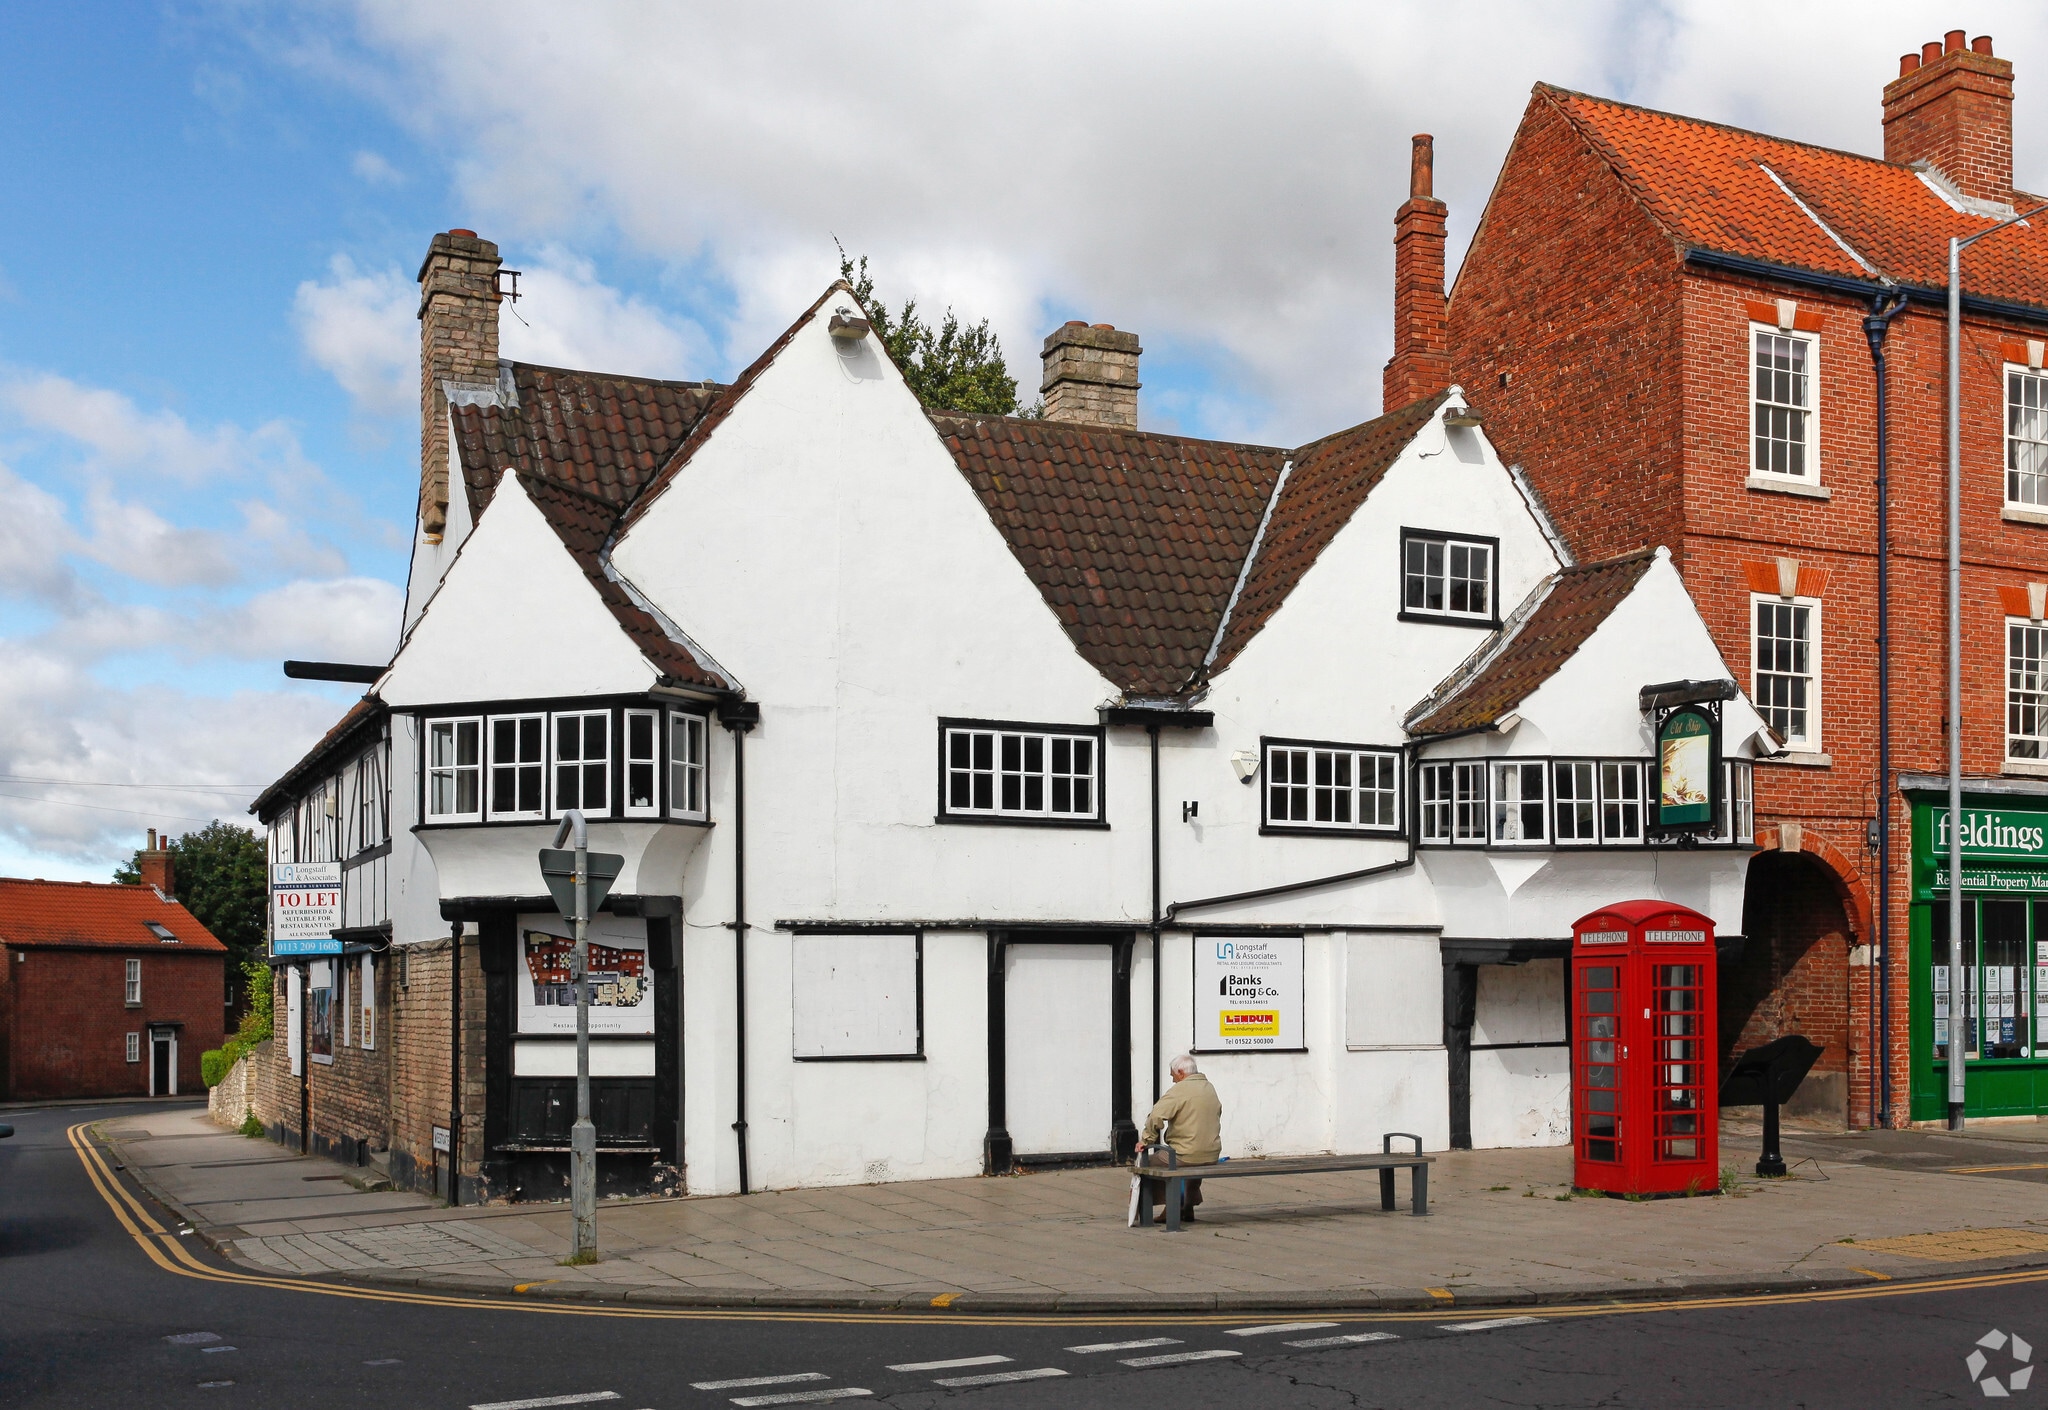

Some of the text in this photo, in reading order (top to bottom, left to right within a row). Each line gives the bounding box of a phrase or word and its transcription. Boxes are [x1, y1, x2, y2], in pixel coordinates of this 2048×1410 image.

[1686, 718, 1702, 735] Ship
[1938, 812, 2043, 852] feldings
[295, 866, 327, 874] Longstaff
[1990, 874, 2029, 890] Property
[276, 893, 339, 907] TO LET
[1582, 931, 1626, 943] TELEPHONE
[1647, 931, 1703, 941] TELEPHONE
[277, 941, 339, 952] 0113 209 1605
[1235, 943, 1268, 952] Longstaff
[1235, 951, 1278, 960] & Associates
[1229, 974, 1262, 986] Banks
[1229, 986, 1279, 998] Long & Co.
